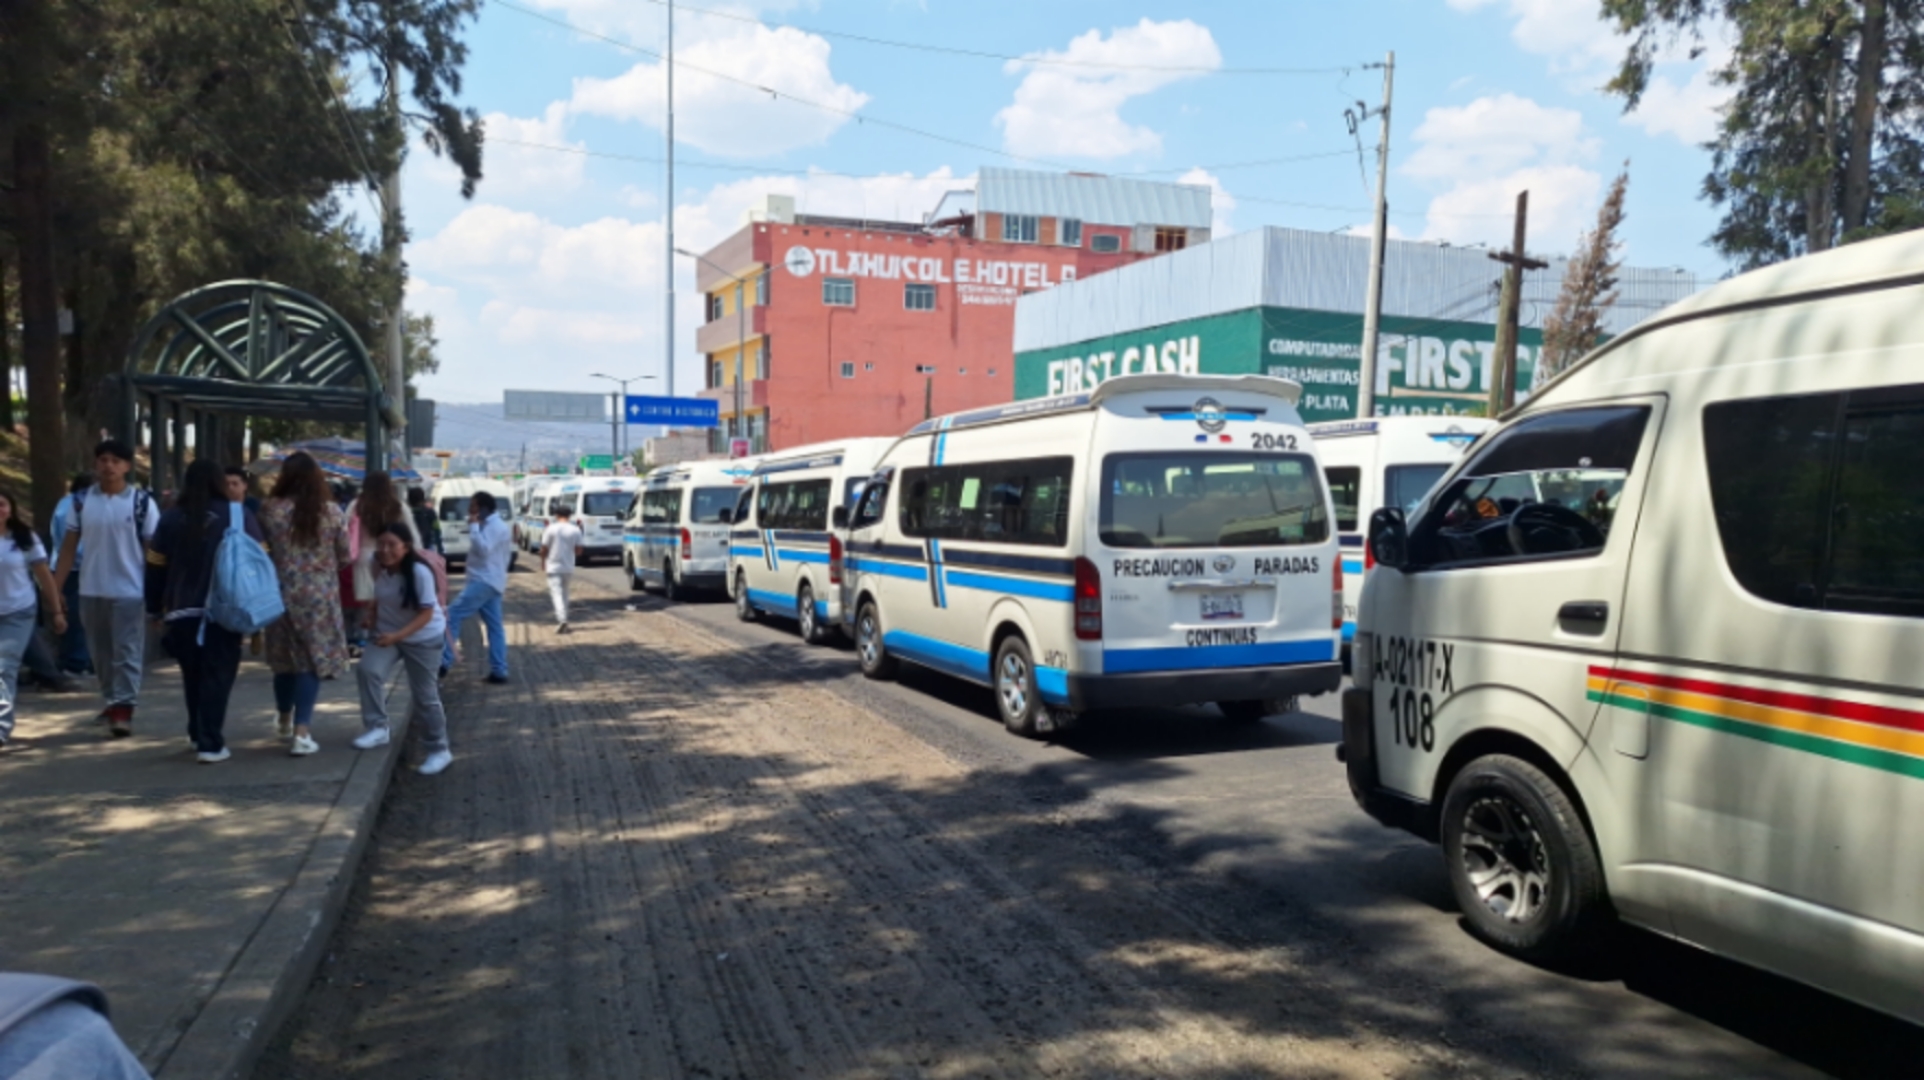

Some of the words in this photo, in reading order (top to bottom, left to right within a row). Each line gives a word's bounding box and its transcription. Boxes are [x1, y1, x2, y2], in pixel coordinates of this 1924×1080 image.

[1047, 351, 1115, 398] FIRST
[1121, 335, 1199, 376] CASH
[1375, 332, 1496, 396] FIRST
[1305, 393, 1349, 412] PLATA
[1251, 432, 1298, 451] 2042
[1113, 558, 1205, 577] PRECAUCION
[1254, 557, 1319, 575] PARADAS
[1186, 627, 1258, 648] CONTINUAS
[1390, 686, 1435, 753] 108
